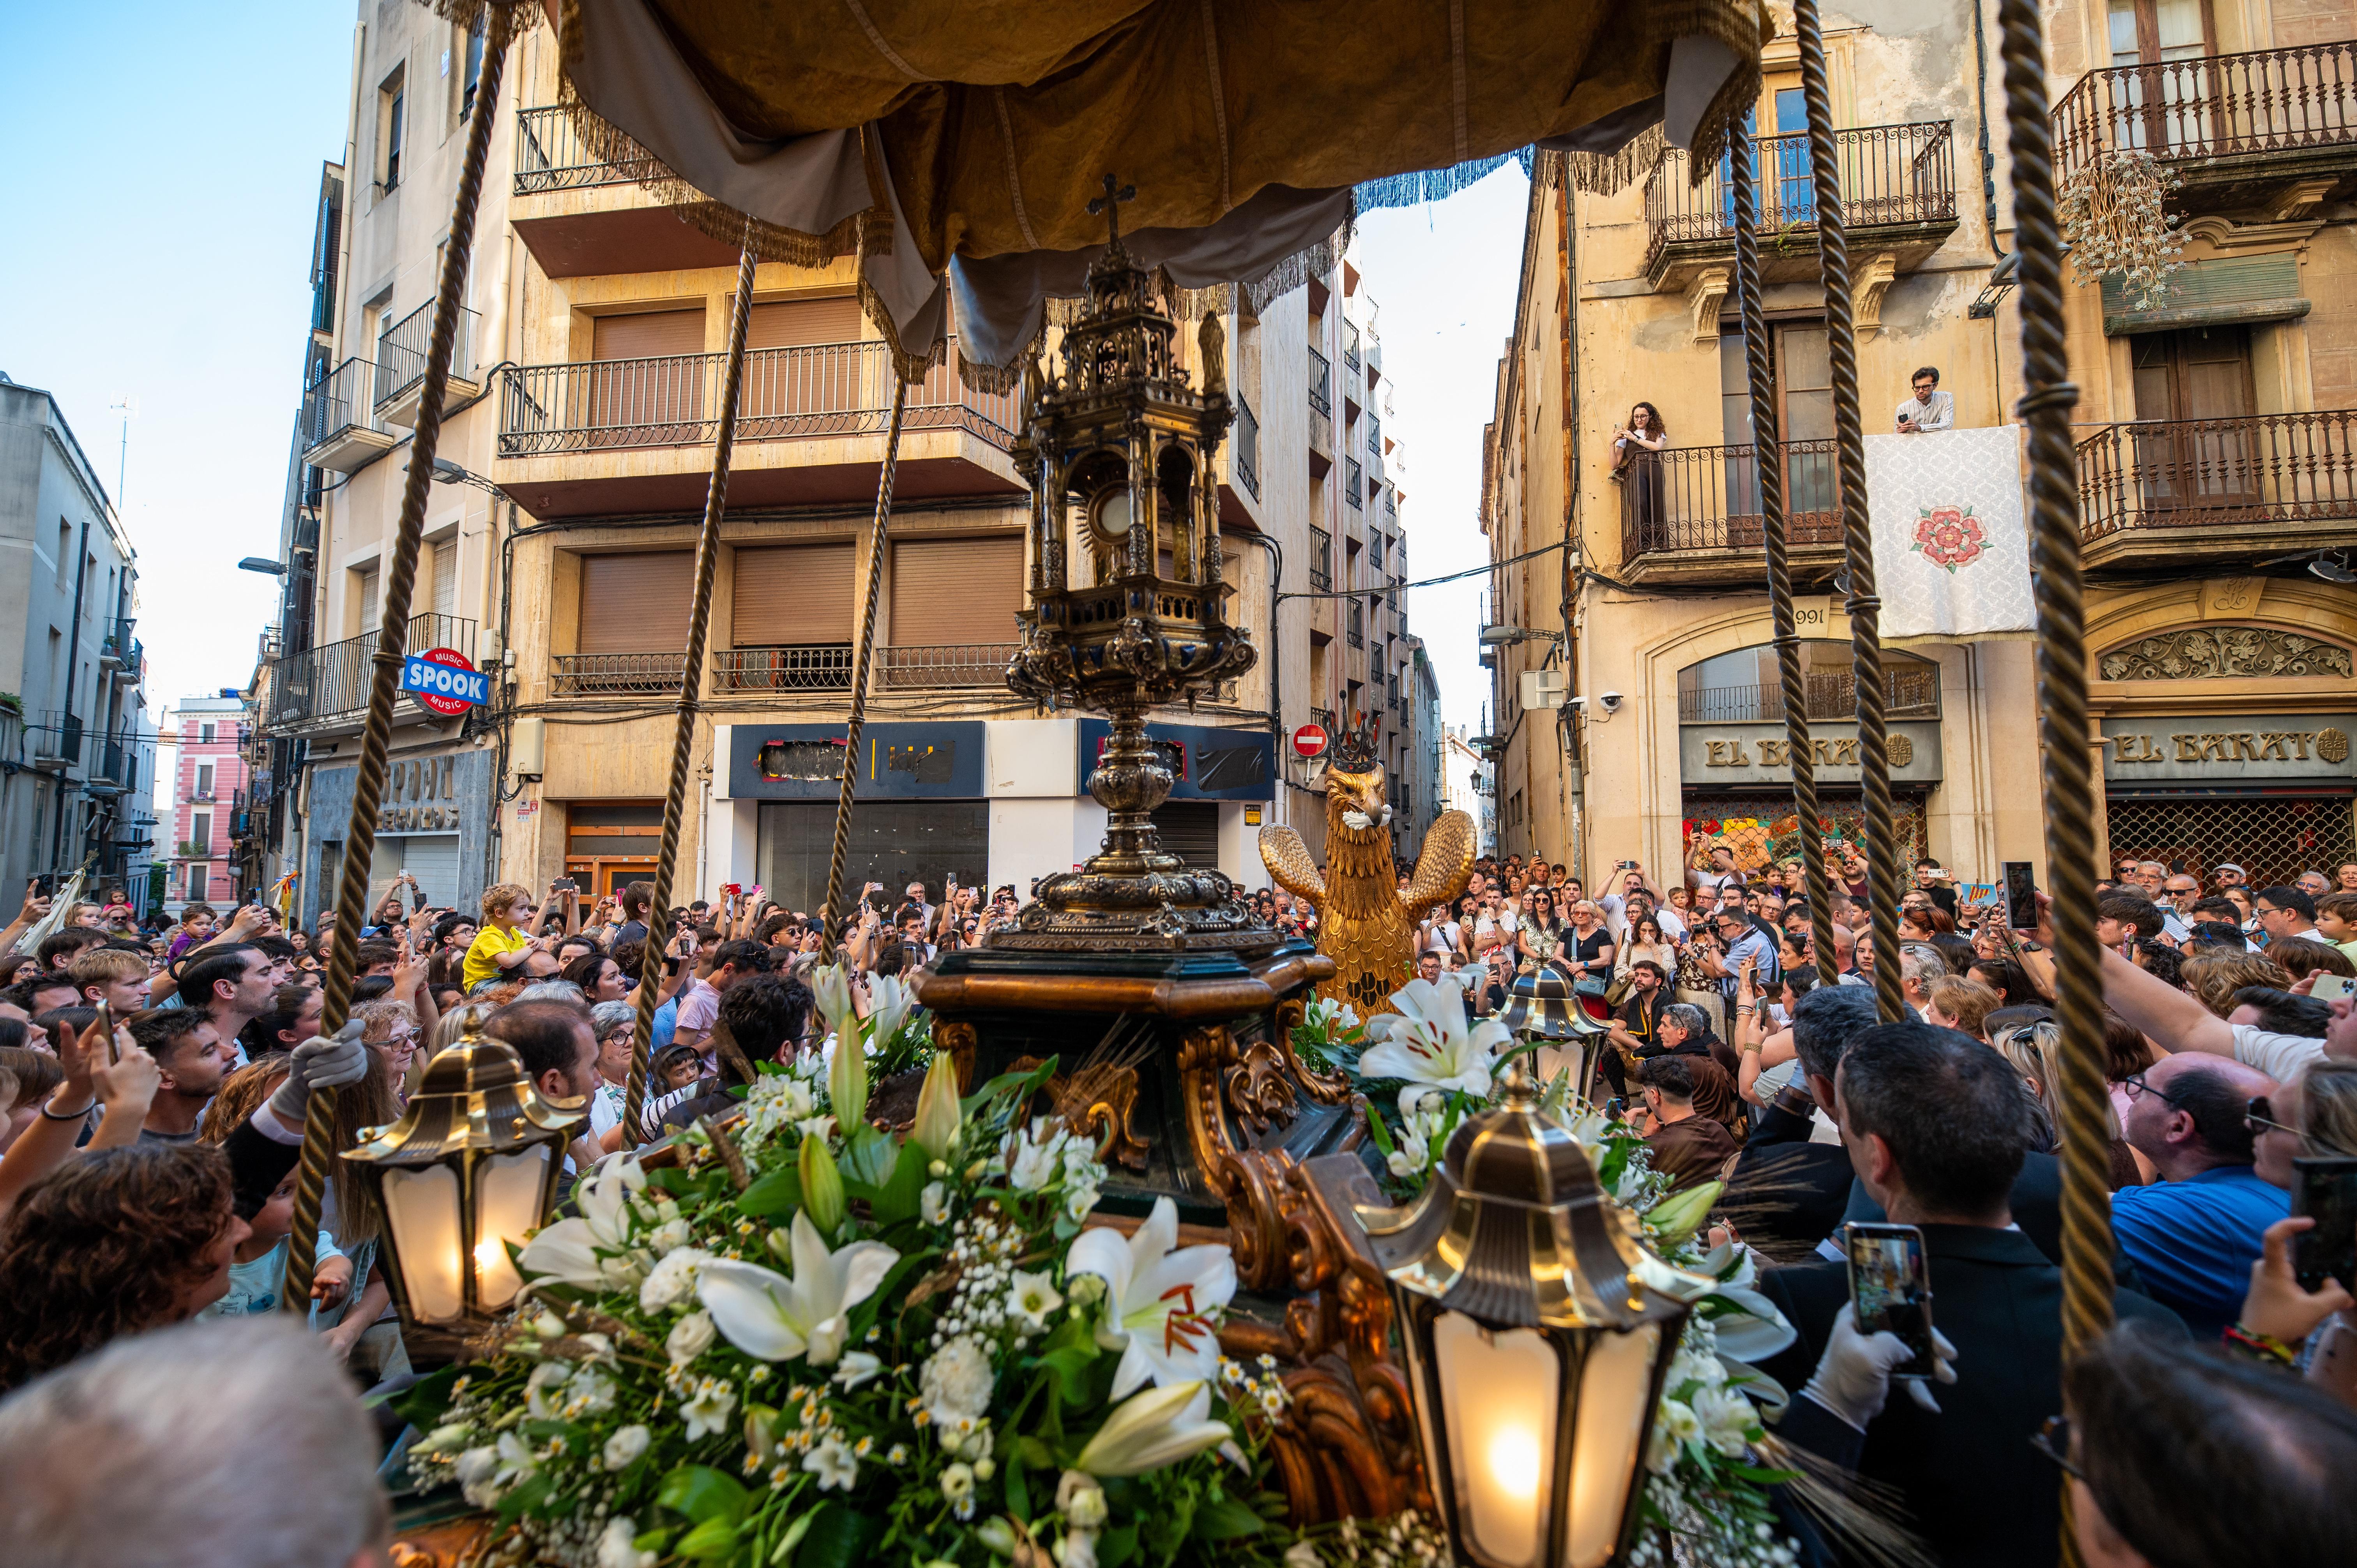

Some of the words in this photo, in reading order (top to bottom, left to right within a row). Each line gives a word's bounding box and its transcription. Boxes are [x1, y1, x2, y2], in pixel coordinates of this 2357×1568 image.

[1793, 609, 1823, 624] 991
[435, 653, 463, 667] MUSIC
[409, 663, 483, 699] SPOOK
[430, 695, 461, 709] MUSIC
[1885, 745, 1911, 754] 1881
[2113, 735, 2164, 762] EL
[2171, 732, 2316, 761] BARAT
[2318, 740, 2347, 749] 1881
[1705, 741, 1750, 766] EL
